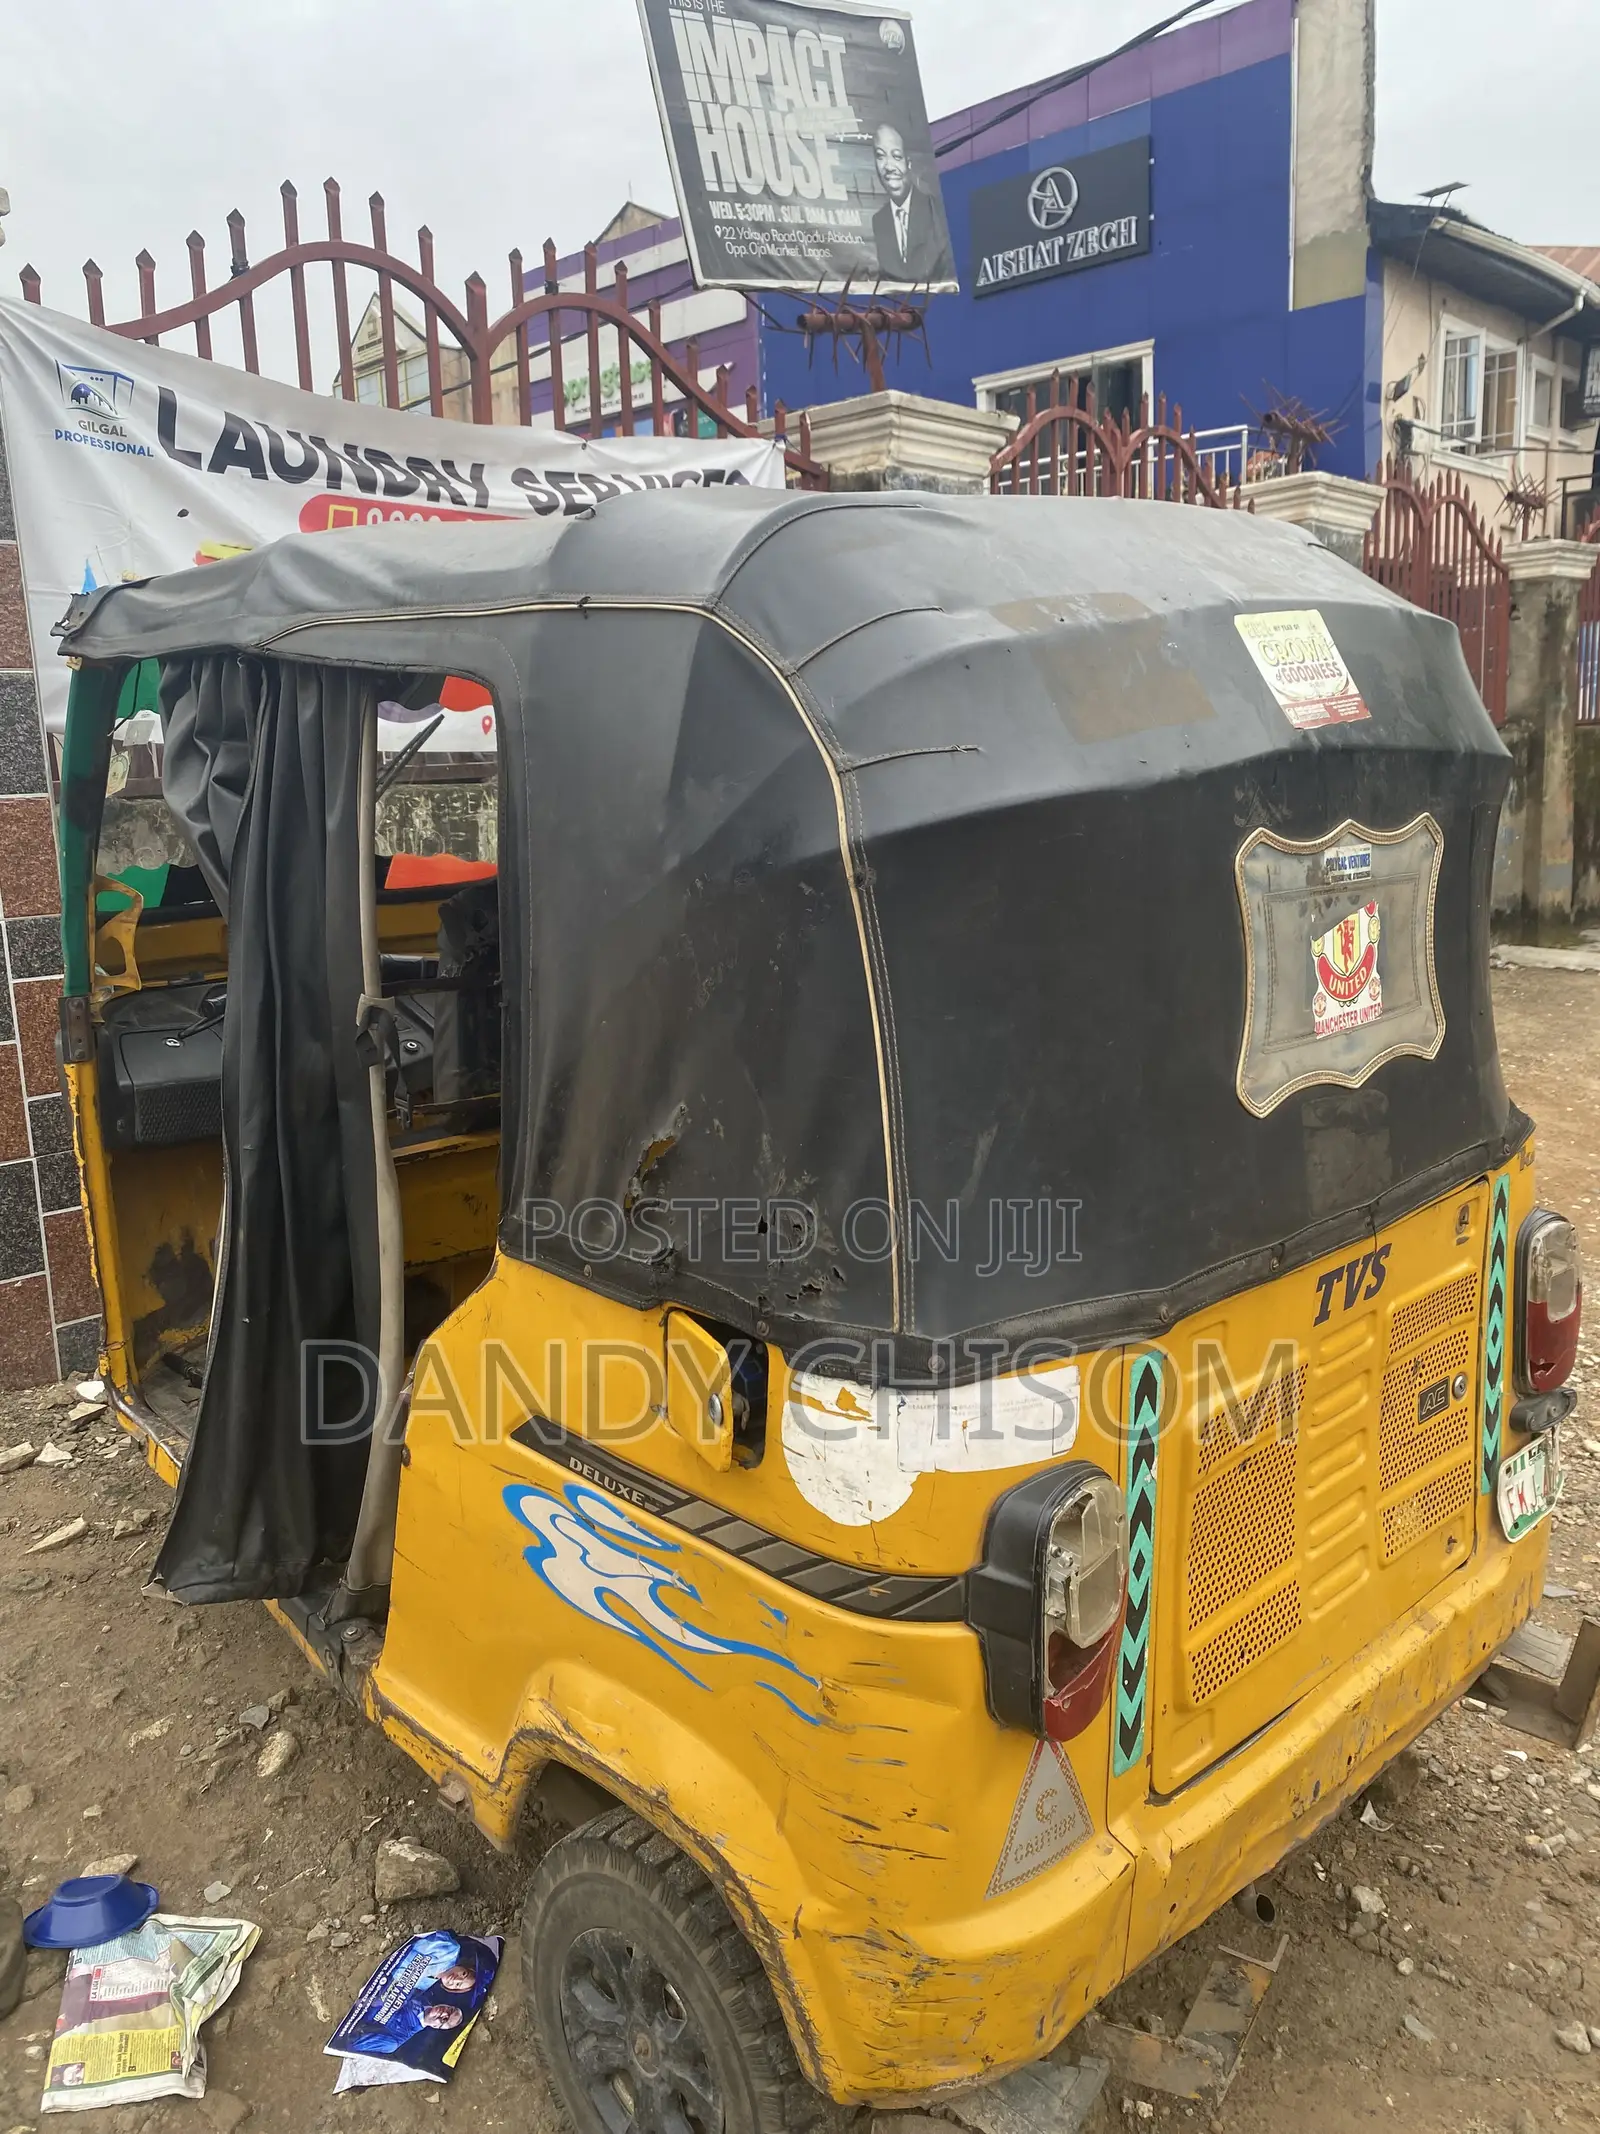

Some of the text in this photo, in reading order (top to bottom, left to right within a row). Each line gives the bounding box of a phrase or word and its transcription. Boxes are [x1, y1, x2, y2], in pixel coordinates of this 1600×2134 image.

[706, 0, 726, 14] THE
[669, 8, 849, 111] IMPACT
[688, 101, 858, 200] HOUSE
[722, 227, 736, 240] 22
[771, 229, 797, 242] Road
[725, 242, 748, 258] Opp.
[976, 216, 1138, 287] AISHAT ZECH
[55, 429, 154, 458] PROFESSIONAL
[78, 420, 127, 438] GILGAL
[158, 386, 489, 508] LAUNDRY
[1258, 636, 1334, 667] CROWN
[1281, 660, 1343, 684] GOODNESS
[1329, 967, 1367, 996] UNITED
[1315, 1010, 1358, 1034] MANCHESTER
[1313, 1243, 1392, 1327] TVS
[569, 1456, 646, 1507] DELUXE
[1014, 1812, 1077, 1864] CAUTION
